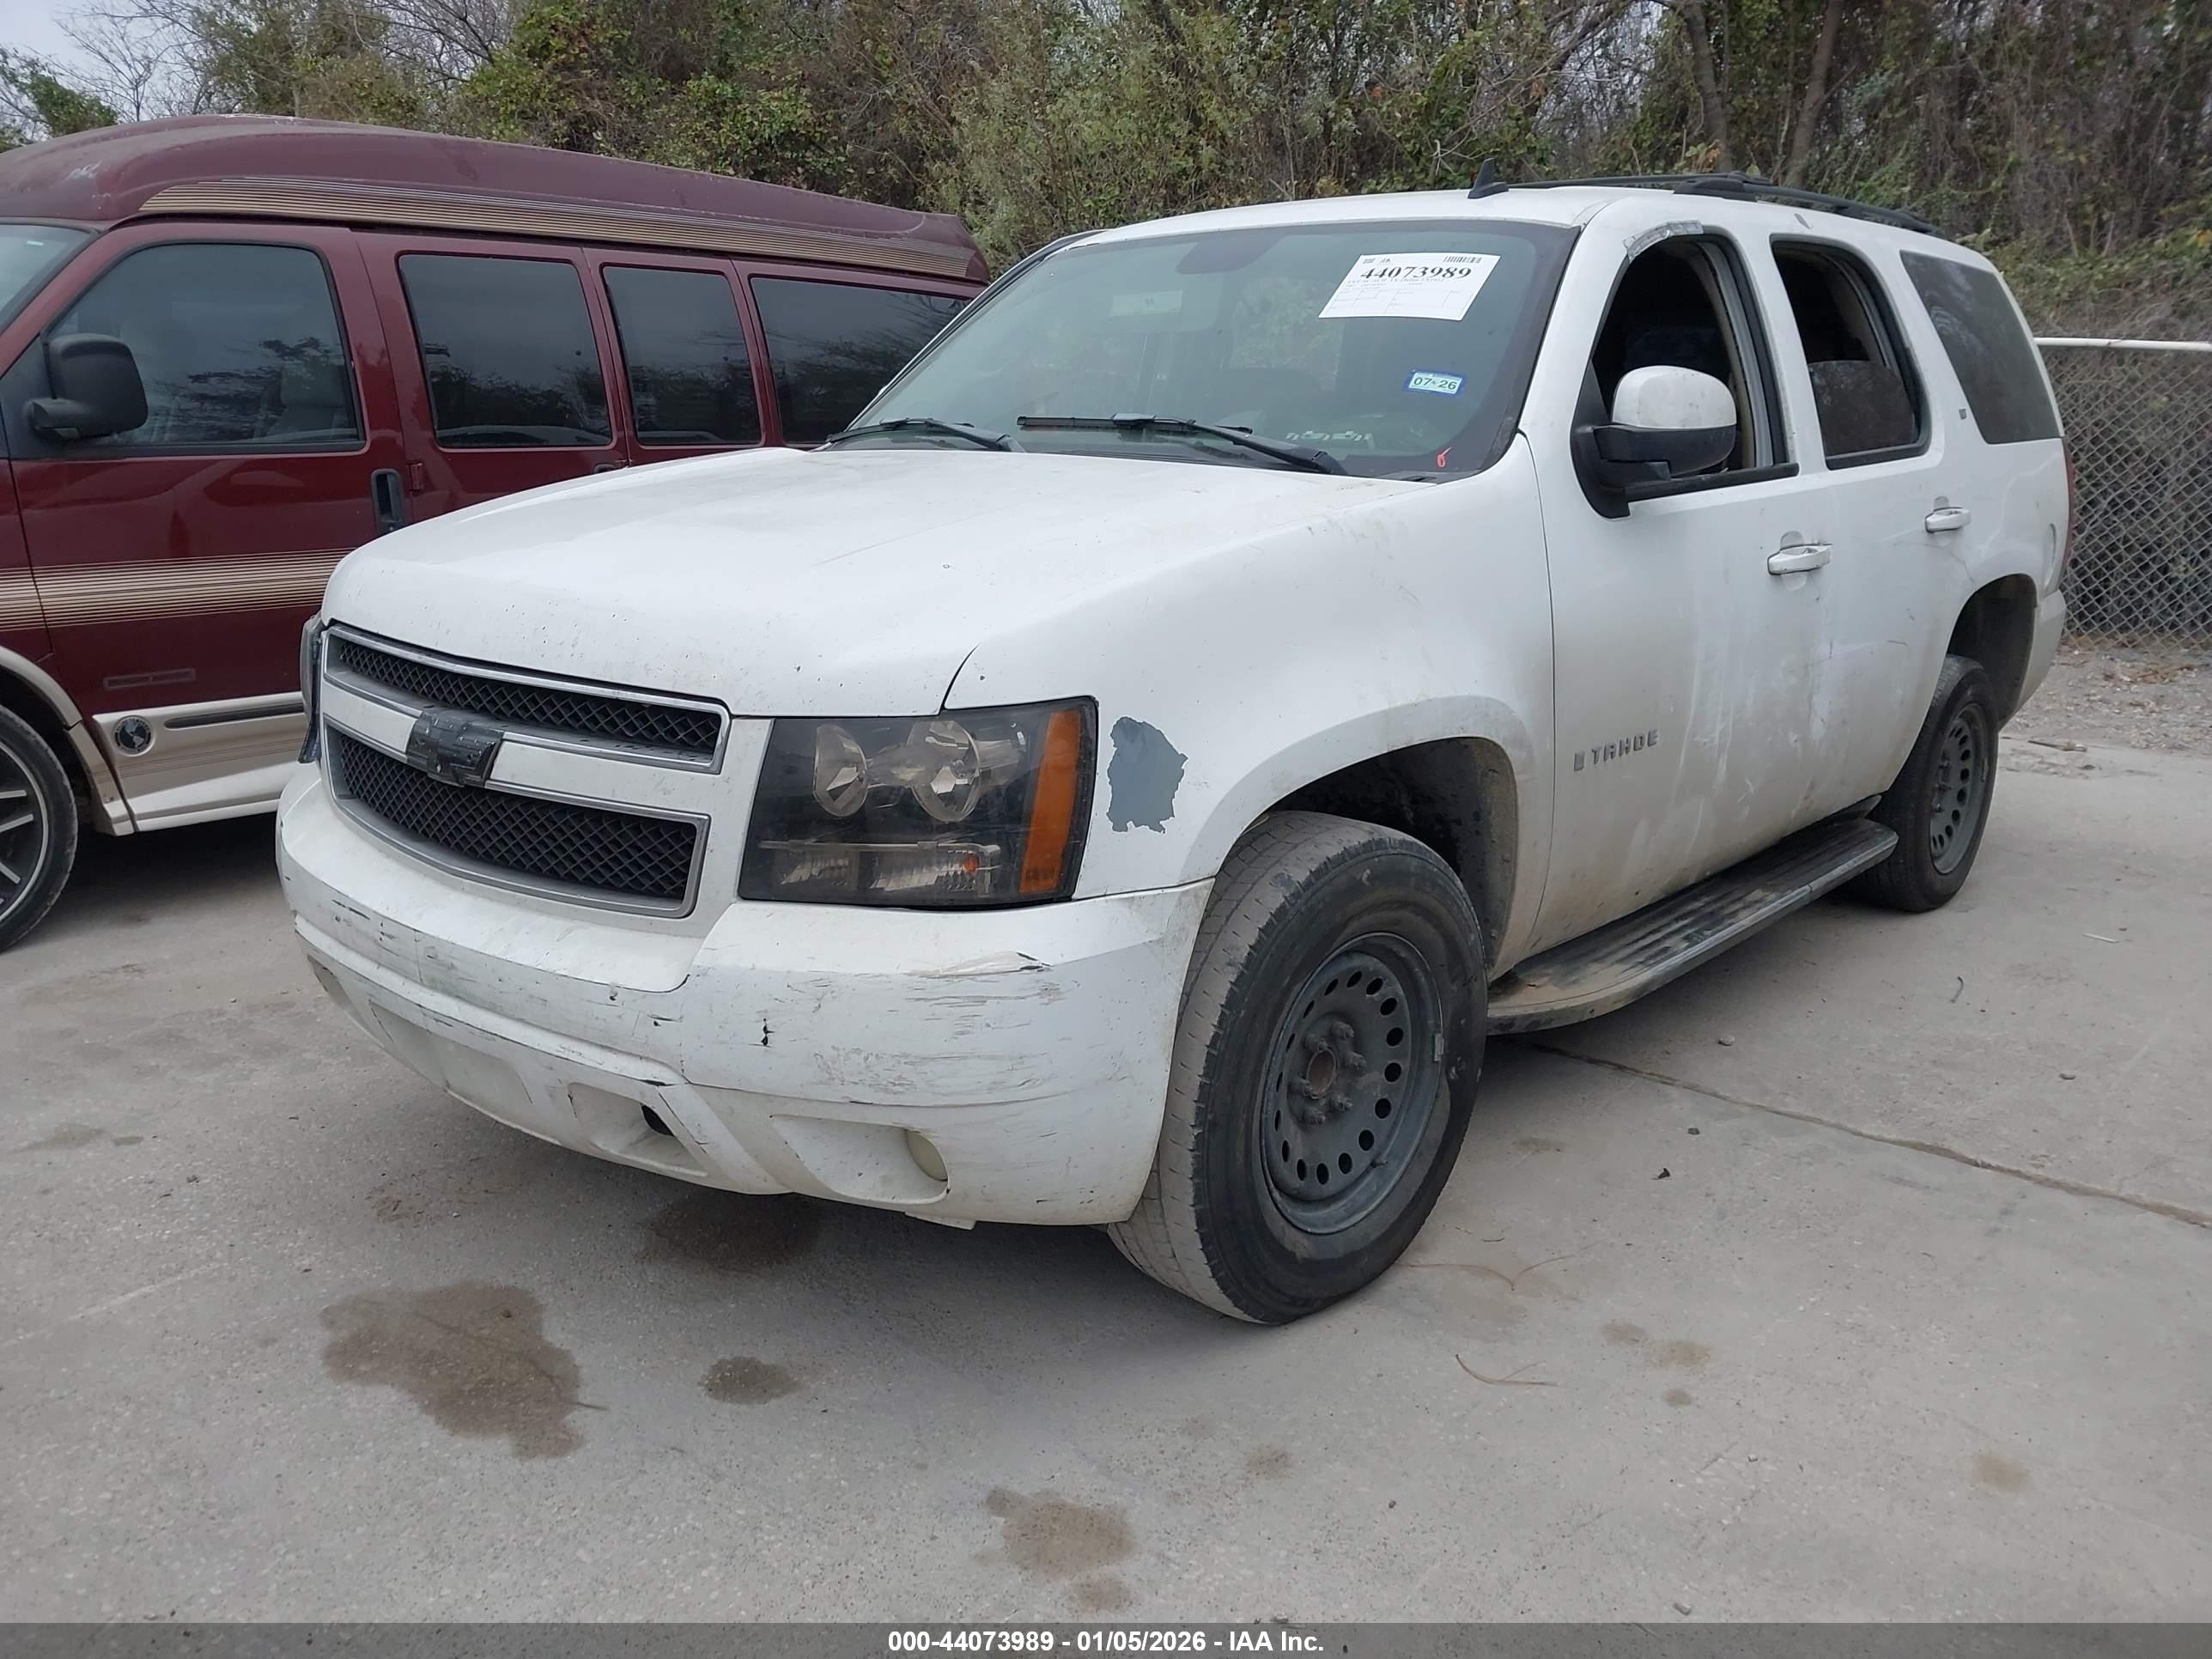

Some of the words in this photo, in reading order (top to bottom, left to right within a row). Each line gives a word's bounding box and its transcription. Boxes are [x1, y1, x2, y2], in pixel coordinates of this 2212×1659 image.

[1360, 265, 1472, 280] 44073989
[1438, 380, 1457, 390] 26
[1591, 728, 1659, 765] TAHOE
